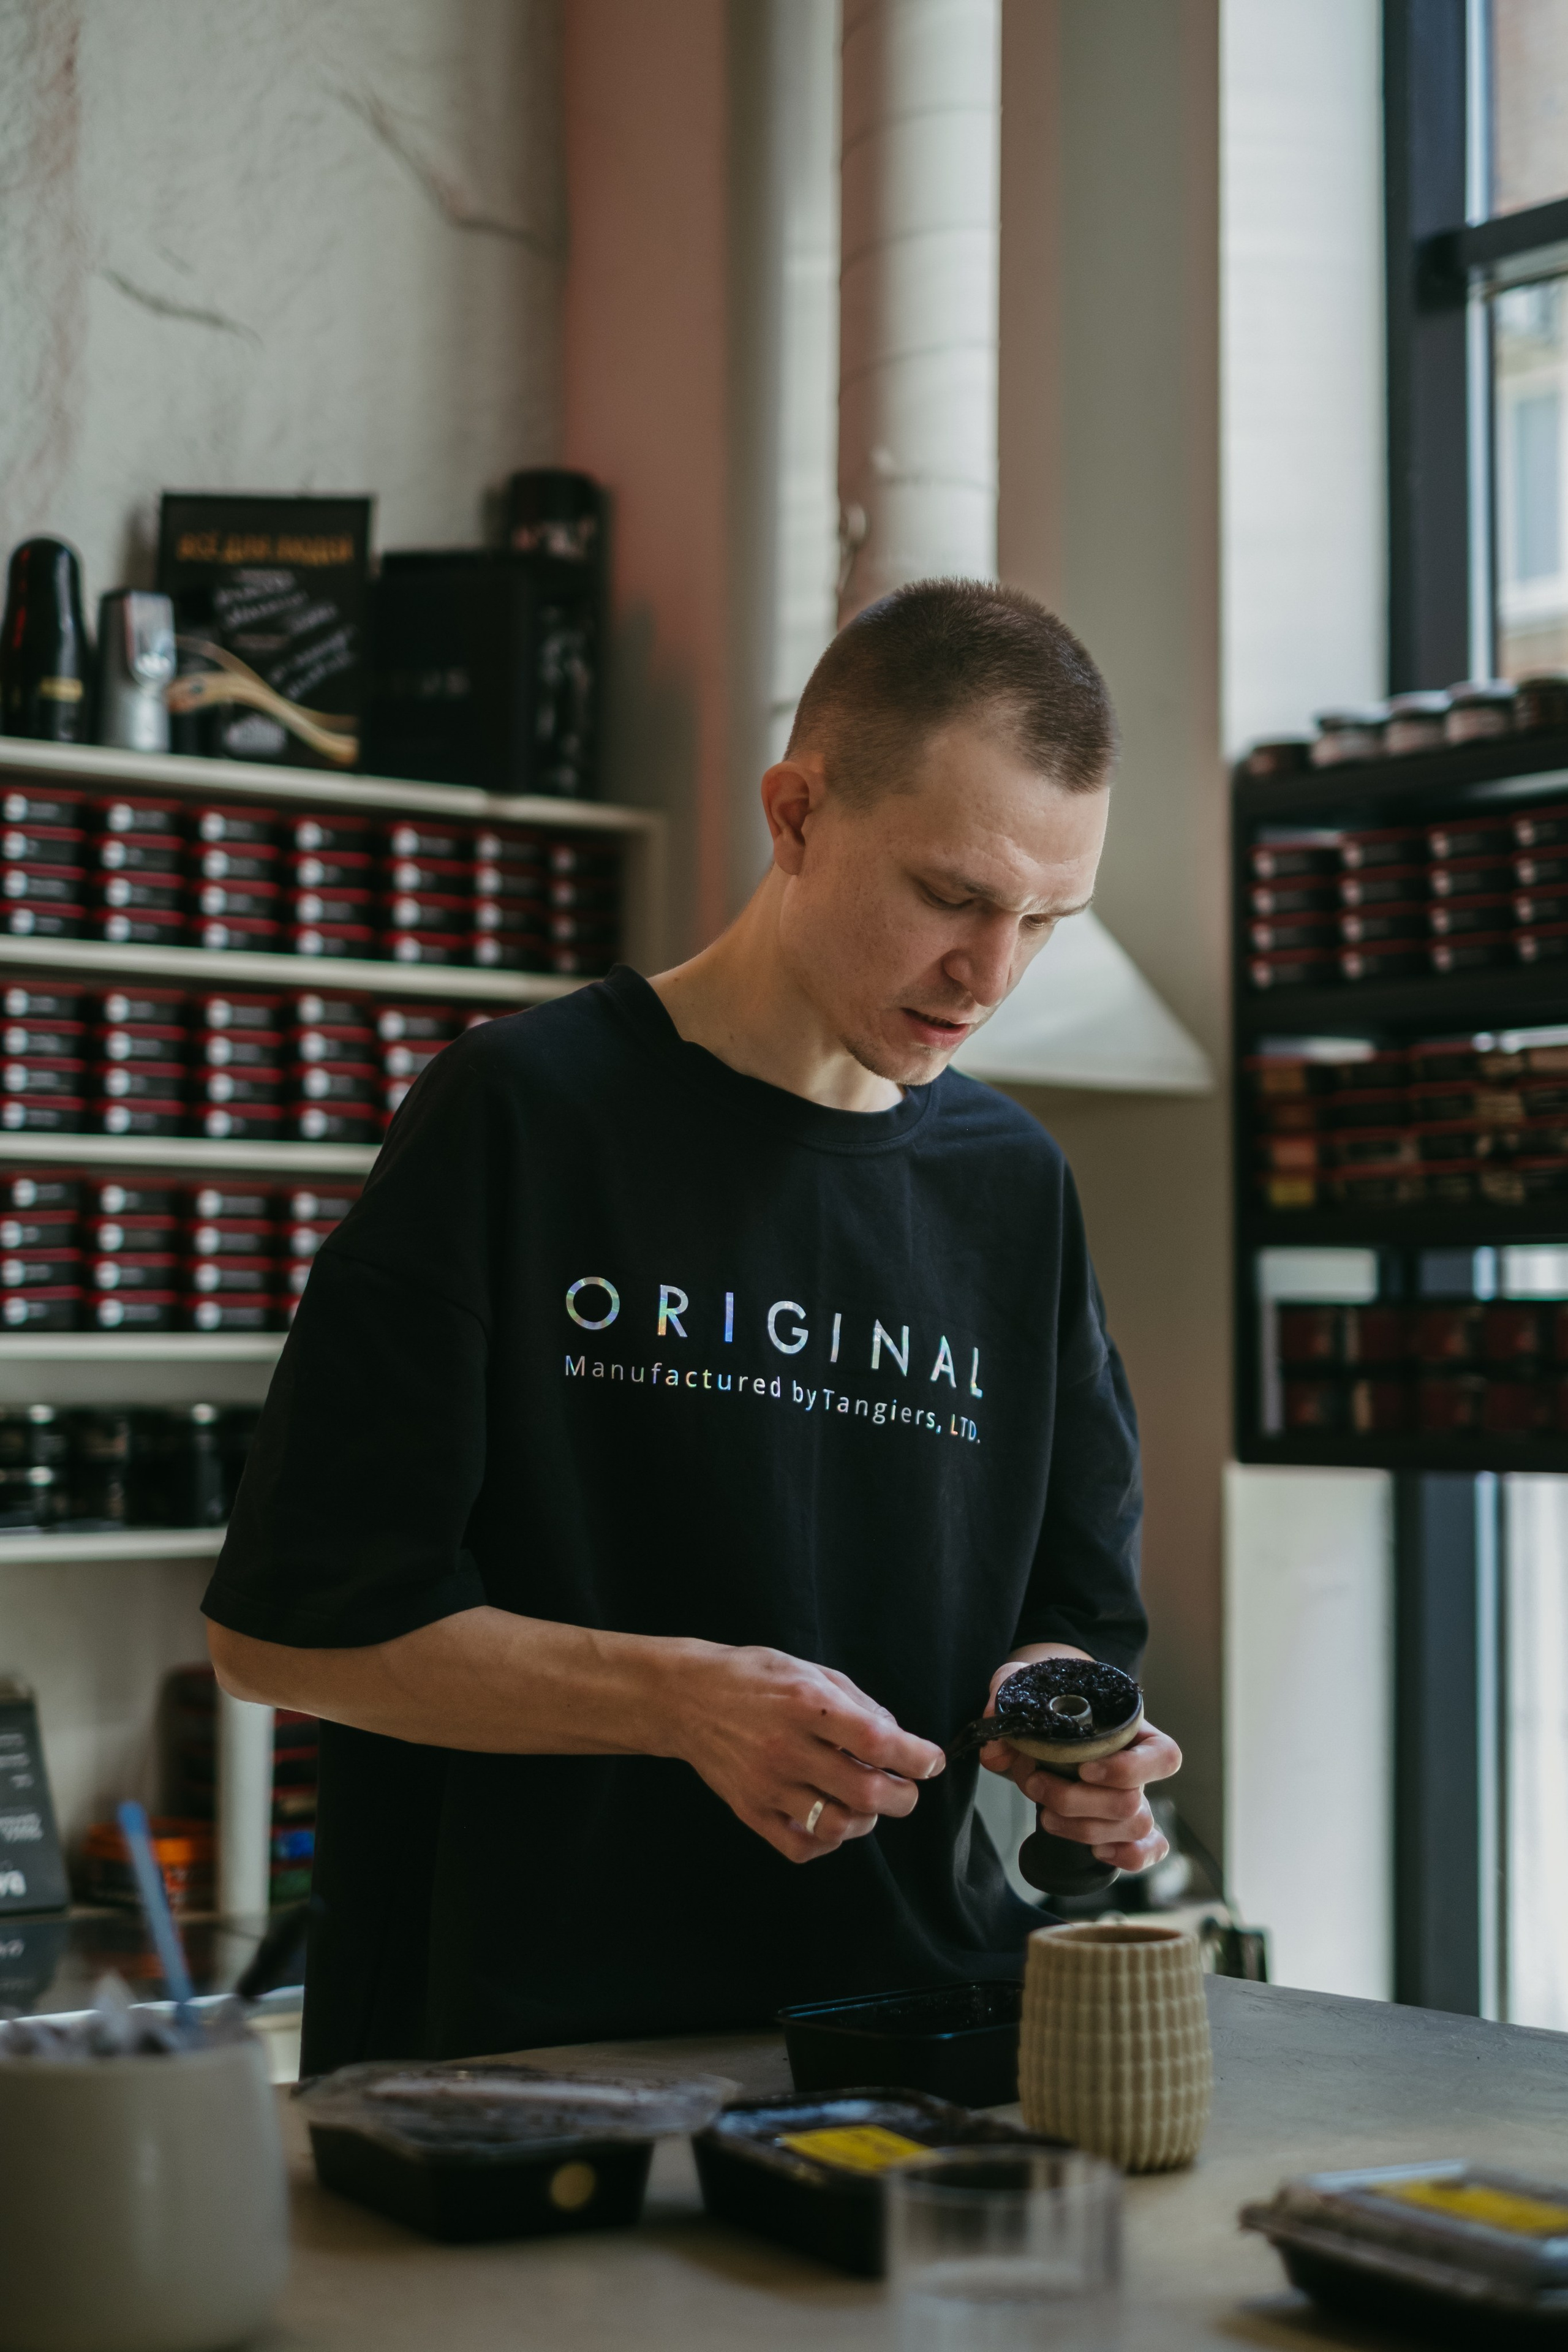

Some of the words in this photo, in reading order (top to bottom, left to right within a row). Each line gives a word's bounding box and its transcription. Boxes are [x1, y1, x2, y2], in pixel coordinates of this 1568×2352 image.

[565, 1276, 984, 1400] ORIGINAL
[565, 1355, 781, 1398] Manufactured
[792, 1379, 817, 1412] by
[822, 1388, 942, 1434] Tangiers,
[949, 1413, 981, 1444] LTD.
